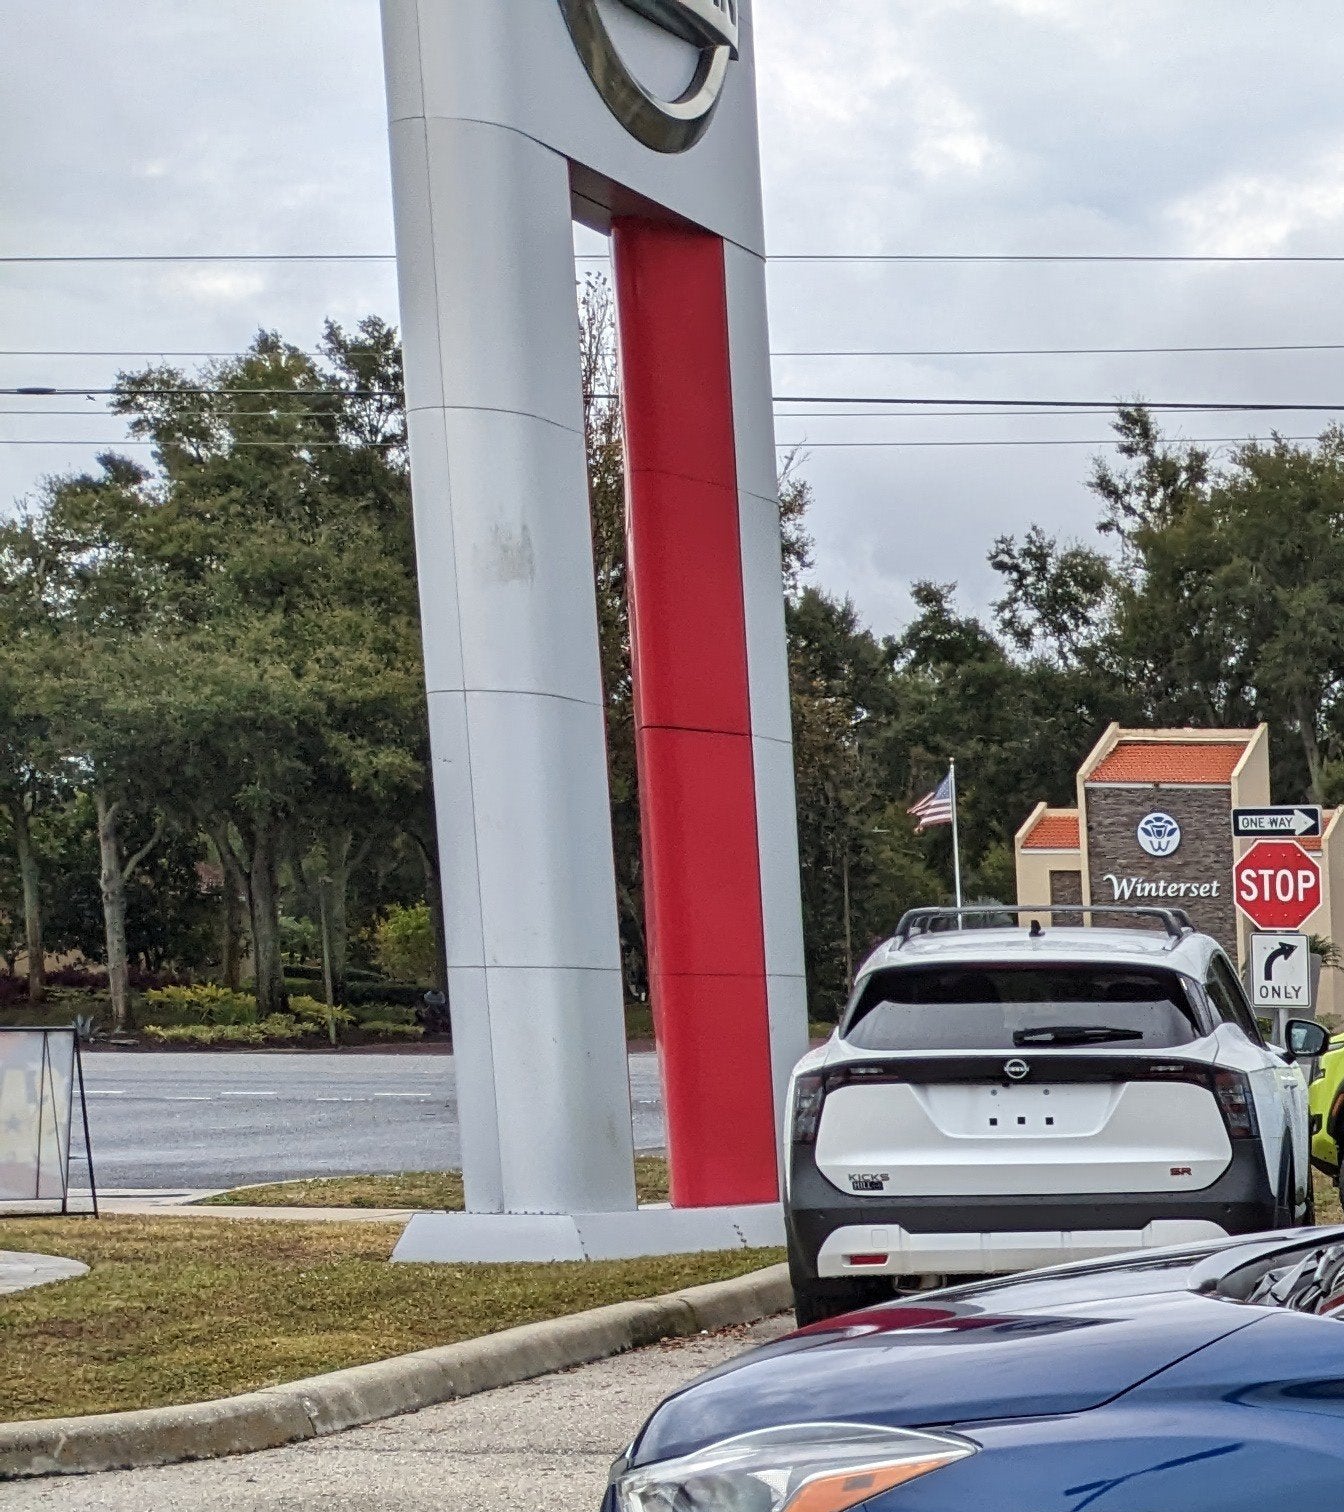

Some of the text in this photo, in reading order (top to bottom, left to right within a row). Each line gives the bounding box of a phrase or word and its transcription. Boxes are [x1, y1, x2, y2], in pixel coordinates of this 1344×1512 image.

[1241, 817, 1293, 829] ONE WAY
[1102, 874, 1220, 900] Winterset
[1240, 868, 1316, 902] STOP
[1259, 985, 1302, 999] ONLY
[848, 1173, 890, 1182] KICKS
[1169, 1167, 1192, 1176] SR
